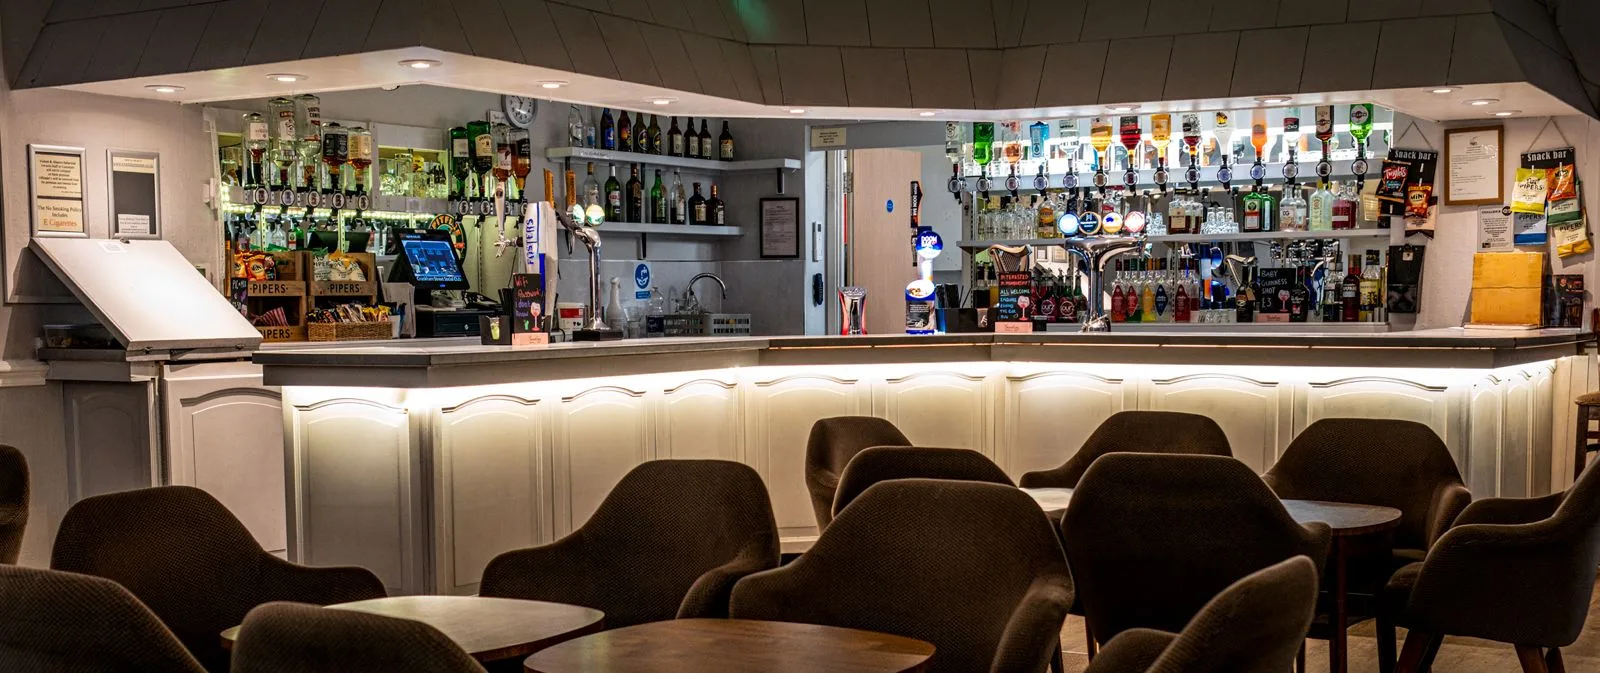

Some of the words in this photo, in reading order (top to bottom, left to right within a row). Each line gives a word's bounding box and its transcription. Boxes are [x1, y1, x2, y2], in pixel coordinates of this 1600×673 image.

[1527, 152, 1551, 162] Snack
[1553, 151, 1567, 159] bar
[49, 219, 77, 228] Cigarettes
[1559, 222, 1583, 231] PIPERS
[252, 283, 286, 294] PIPERS
[329, 283, 360, 293] PIPERS
